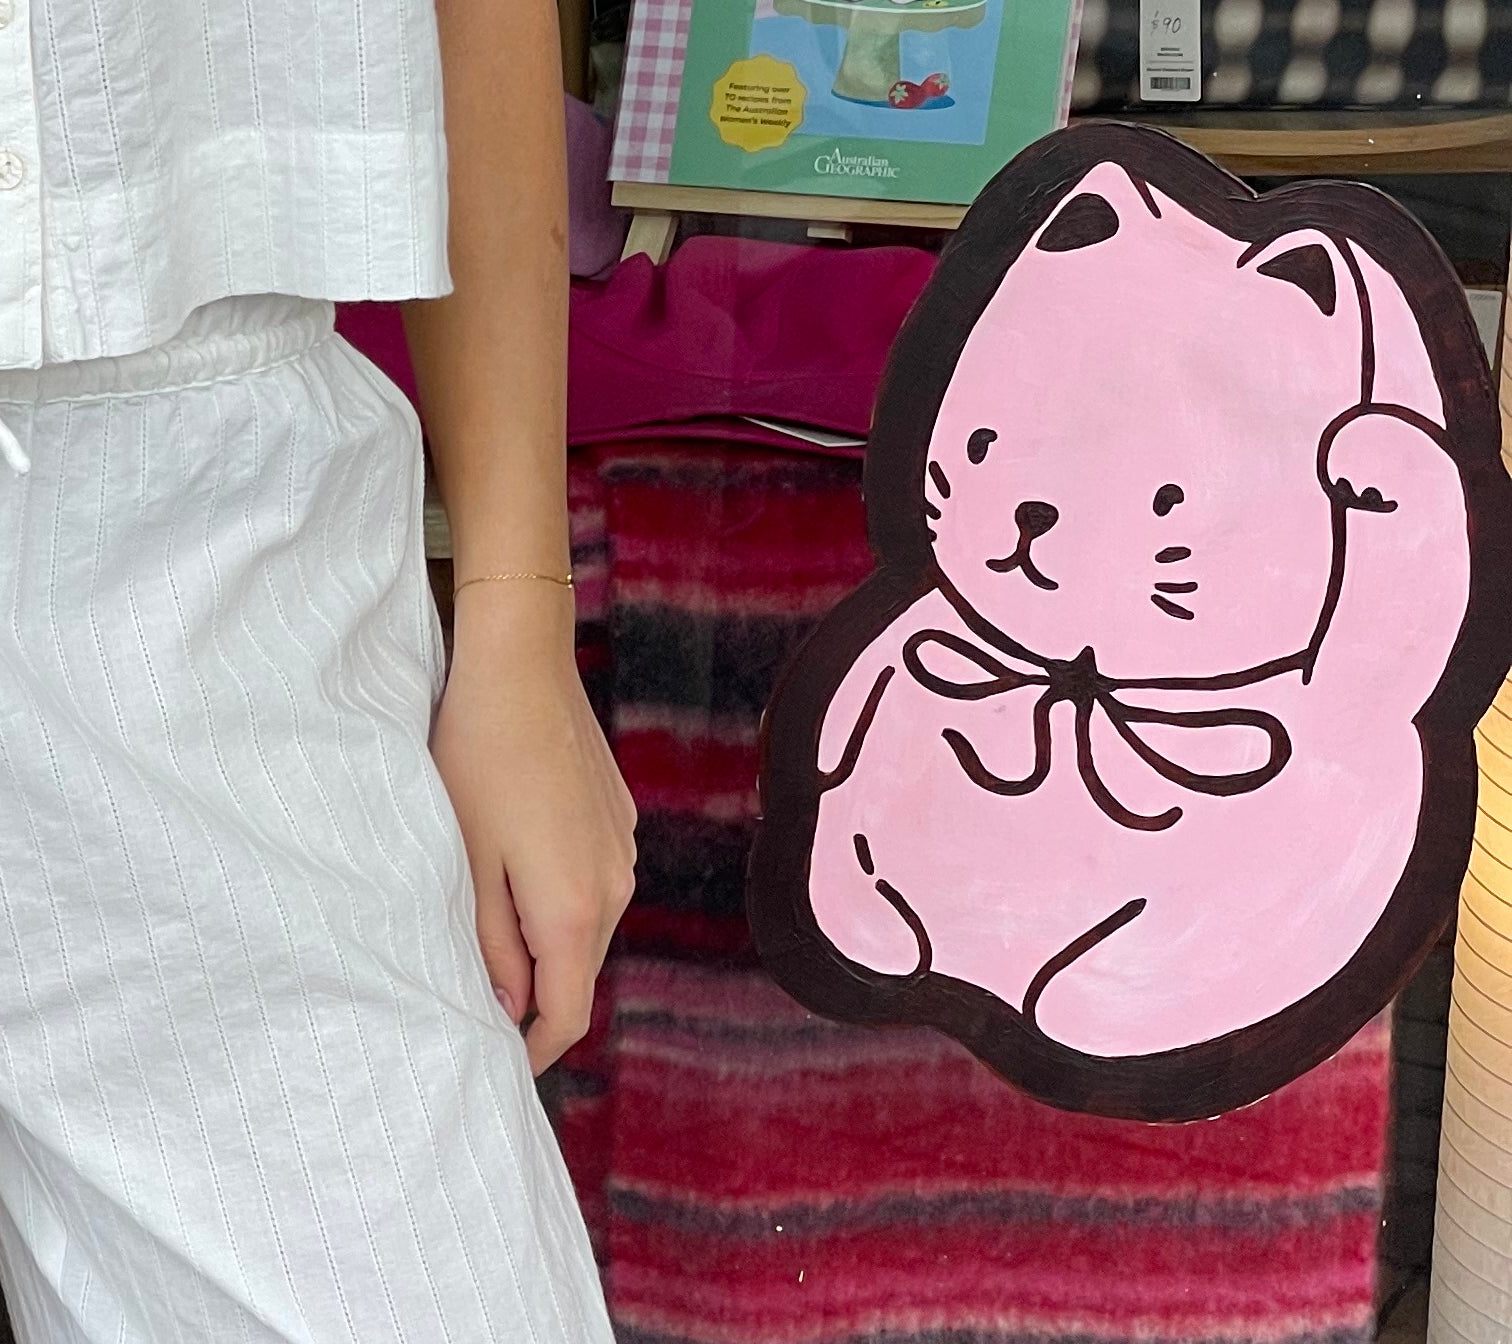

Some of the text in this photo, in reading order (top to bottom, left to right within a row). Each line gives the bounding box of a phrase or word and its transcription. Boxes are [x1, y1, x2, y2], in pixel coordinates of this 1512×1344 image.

[772, 97, 792, 105] from
[743, 106, 788, 115] Australian
[830, 147, 889, 167] Australian
[814, 155, 901, 178] GEOGRAPHIC
